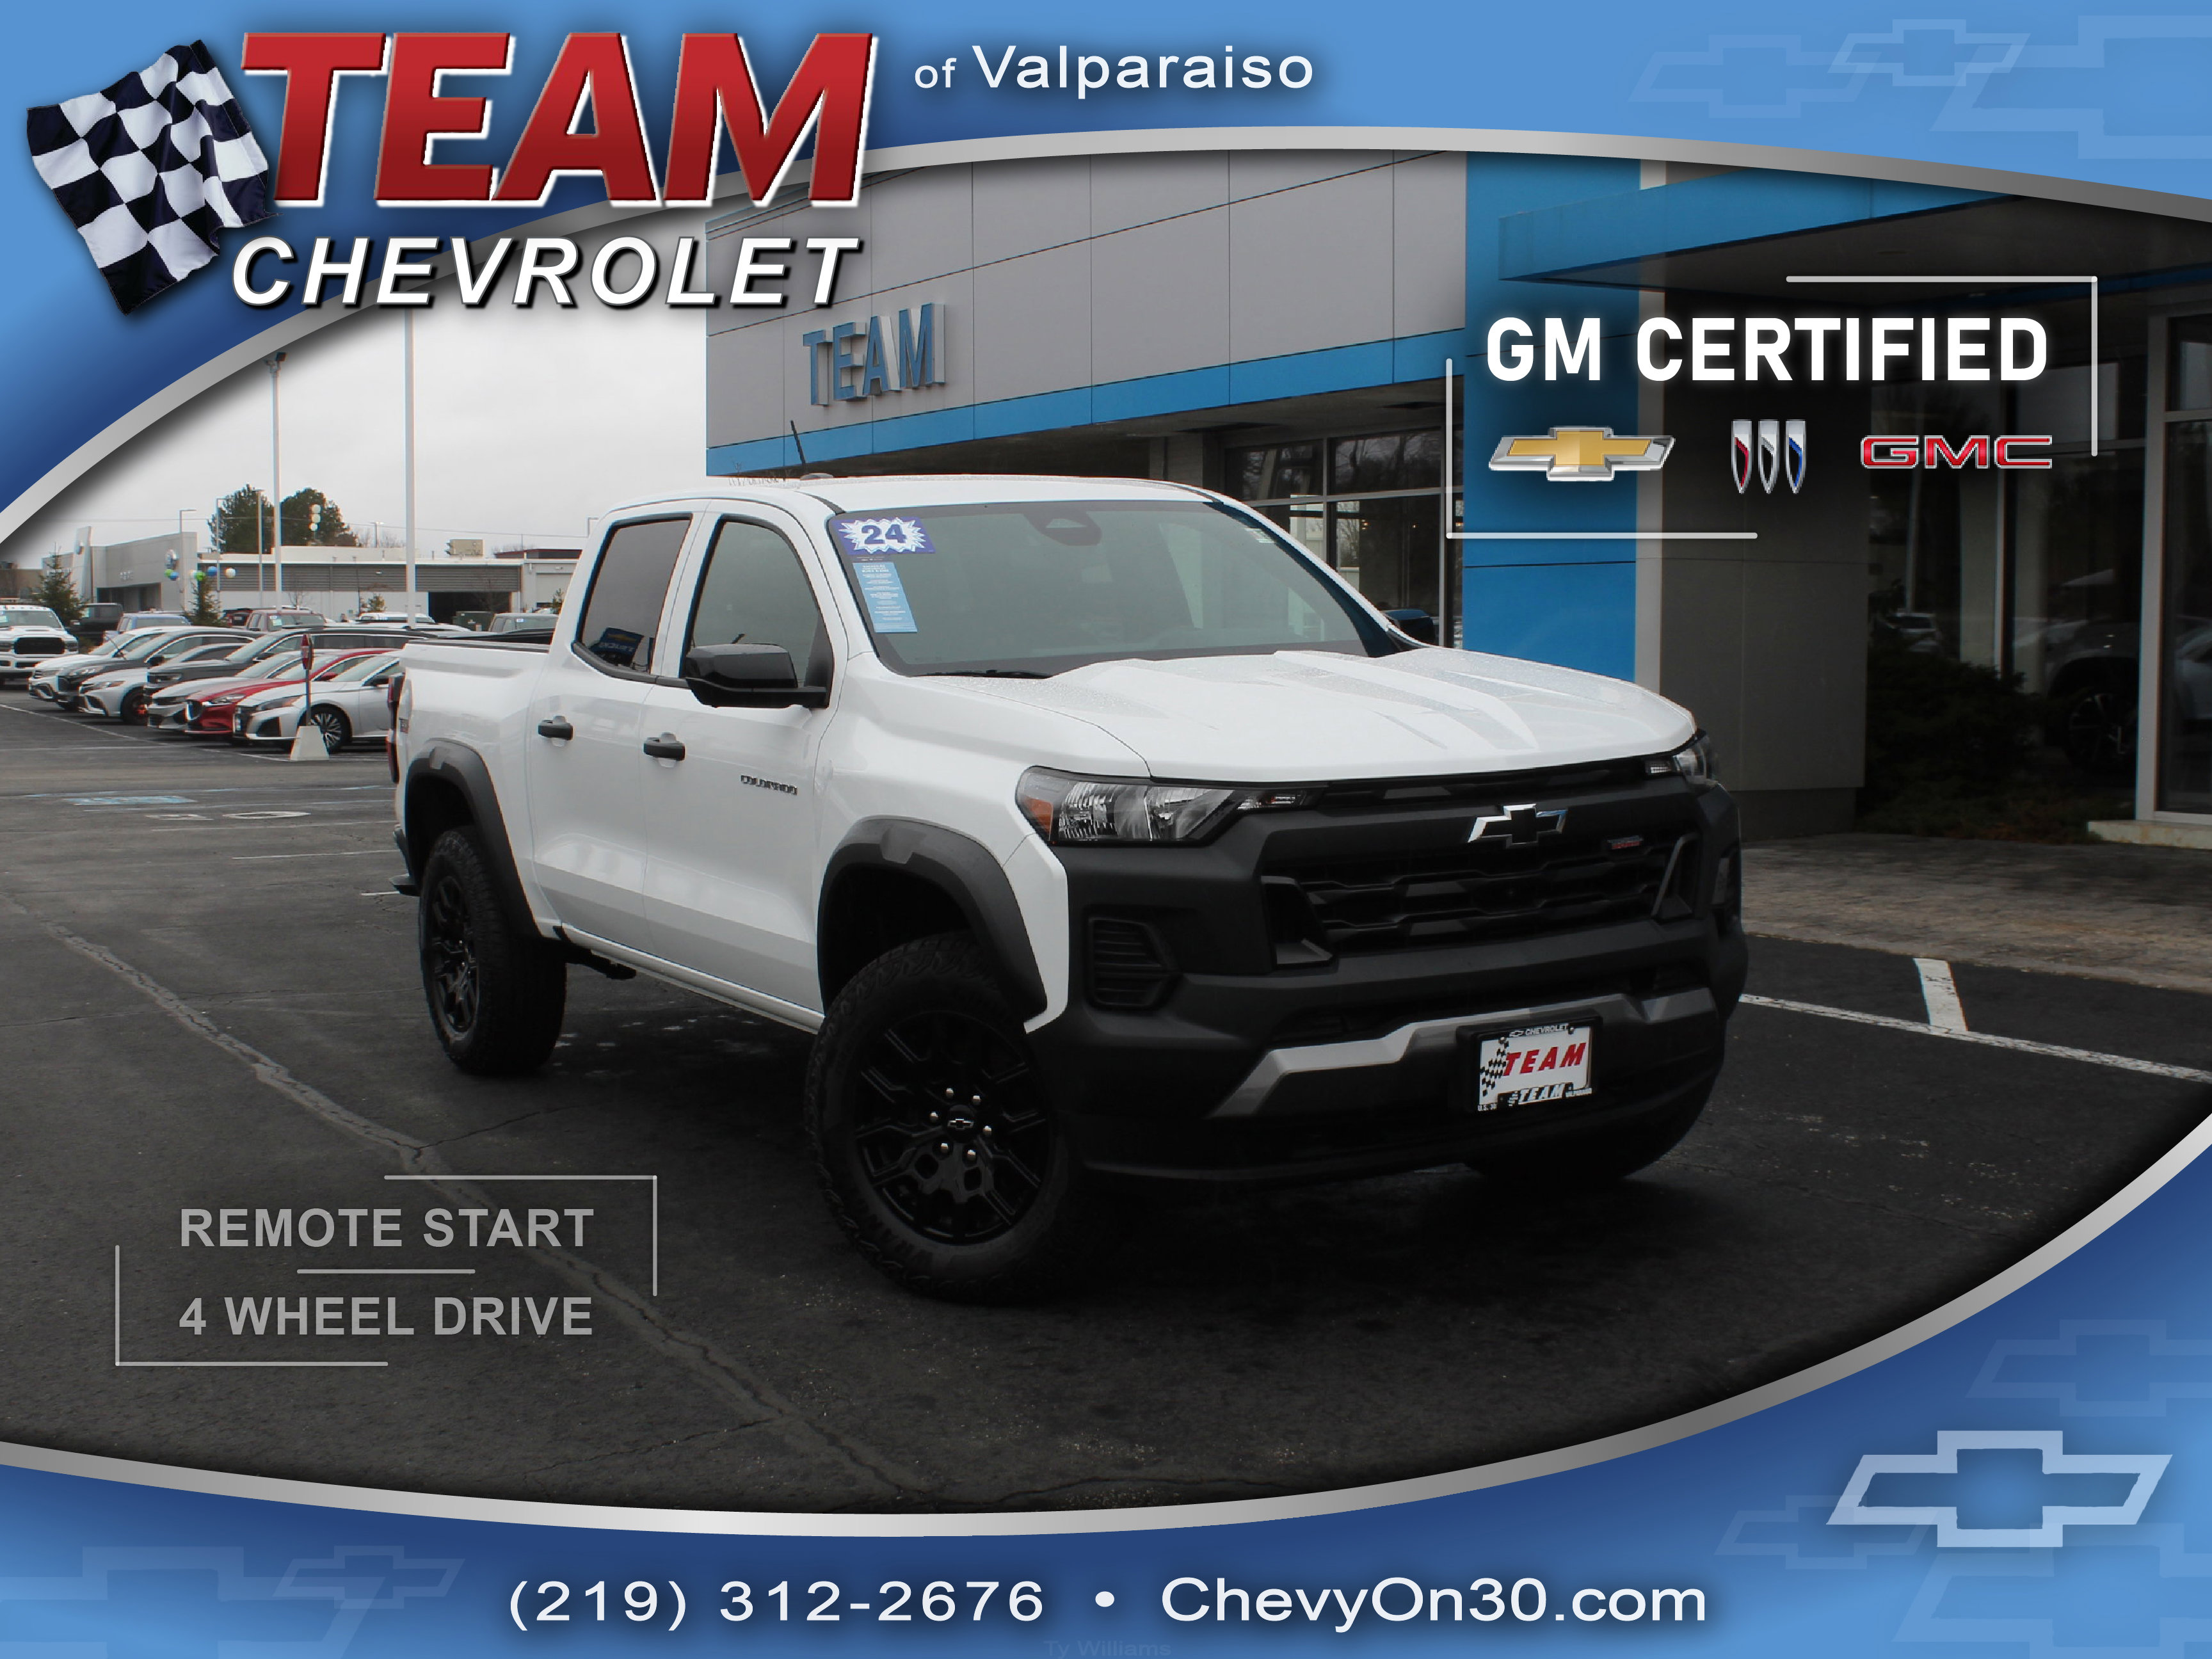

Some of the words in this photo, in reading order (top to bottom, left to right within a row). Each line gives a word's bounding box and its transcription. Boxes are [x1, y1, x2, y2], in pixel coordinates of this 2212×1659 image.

[802, 301, 946, 406] TEAM
[861, 524, 907, 545] 24
[1525, 1023, 1568, 1036] CHEVROLET
[1503, 1042, 1587, 1077] TEAM
[1518, 1083, 1566, 1105] TEAM
